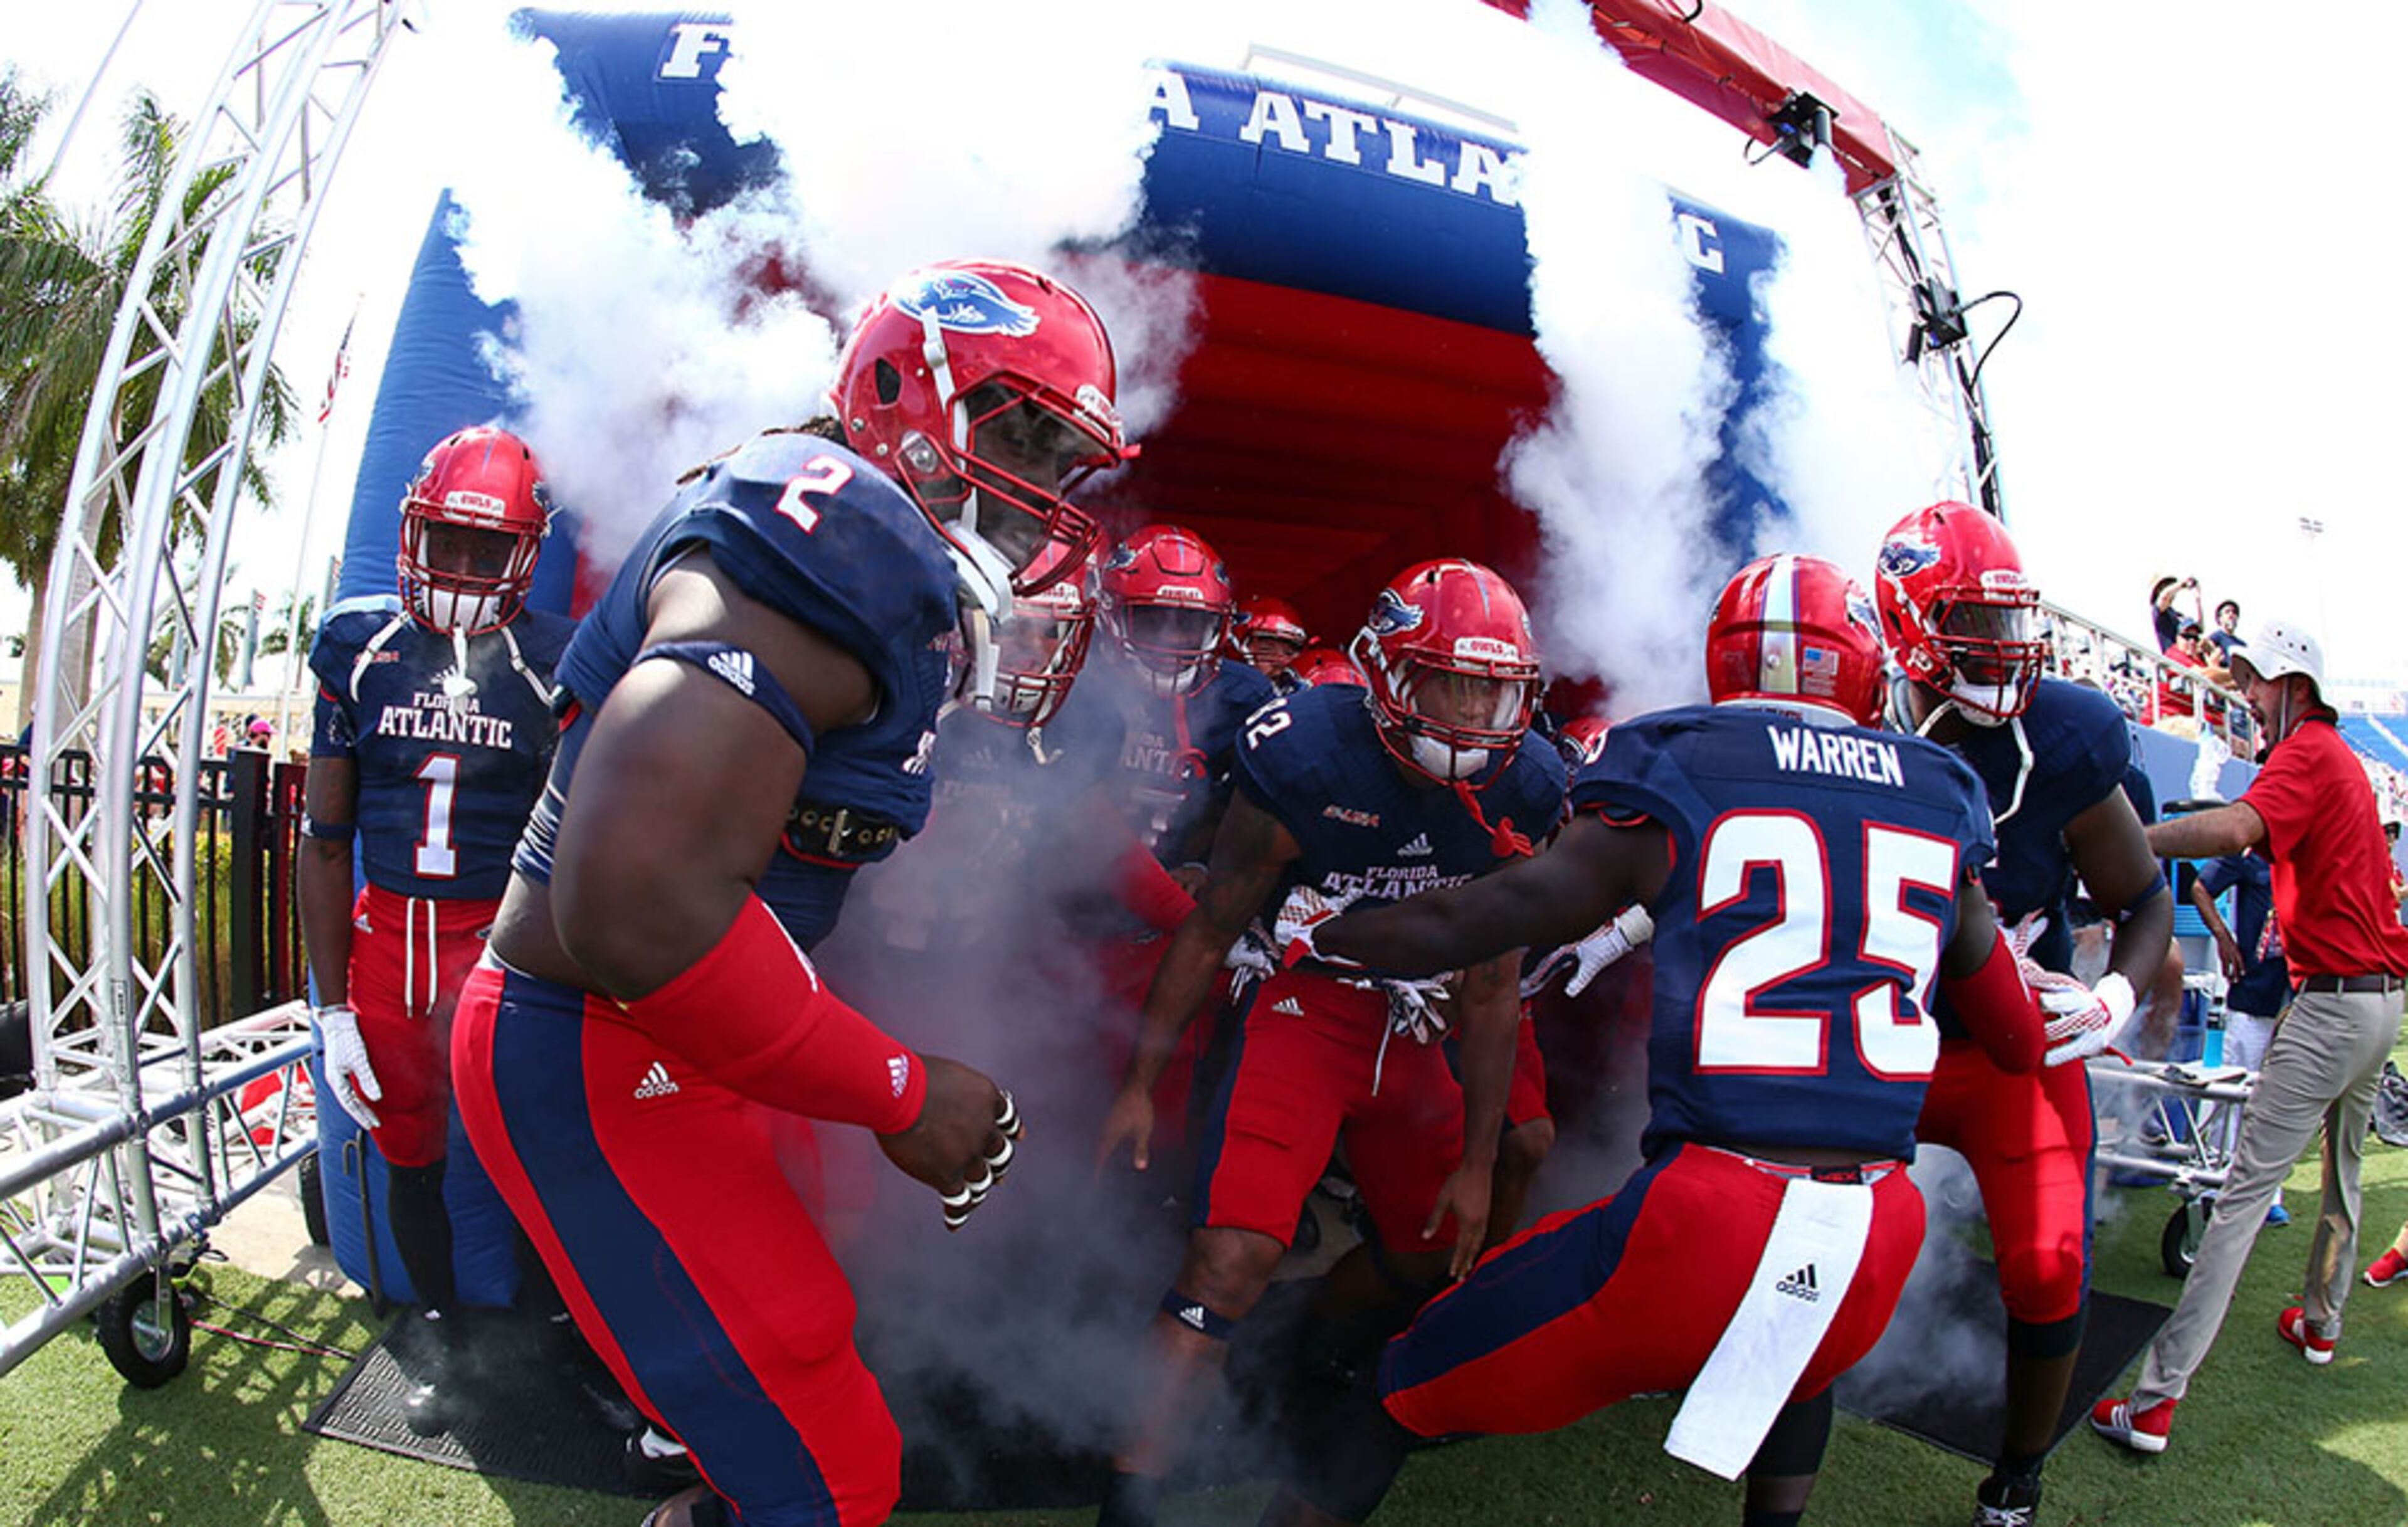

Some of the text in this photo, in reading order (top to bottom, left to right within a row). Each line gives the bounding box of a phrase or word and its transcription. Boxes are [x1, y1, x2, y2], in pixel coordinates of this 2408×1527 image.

[773, 454, 857, 536] 2
[378, 705, 513, 749] ATLANTIC
[1766, 724, 1905, 787] WARREN
[412, 751, 462, 880] 1
[1365, 864, 1439, 880] FLORIDA
[1693, 807, 1961, 1082] 25
